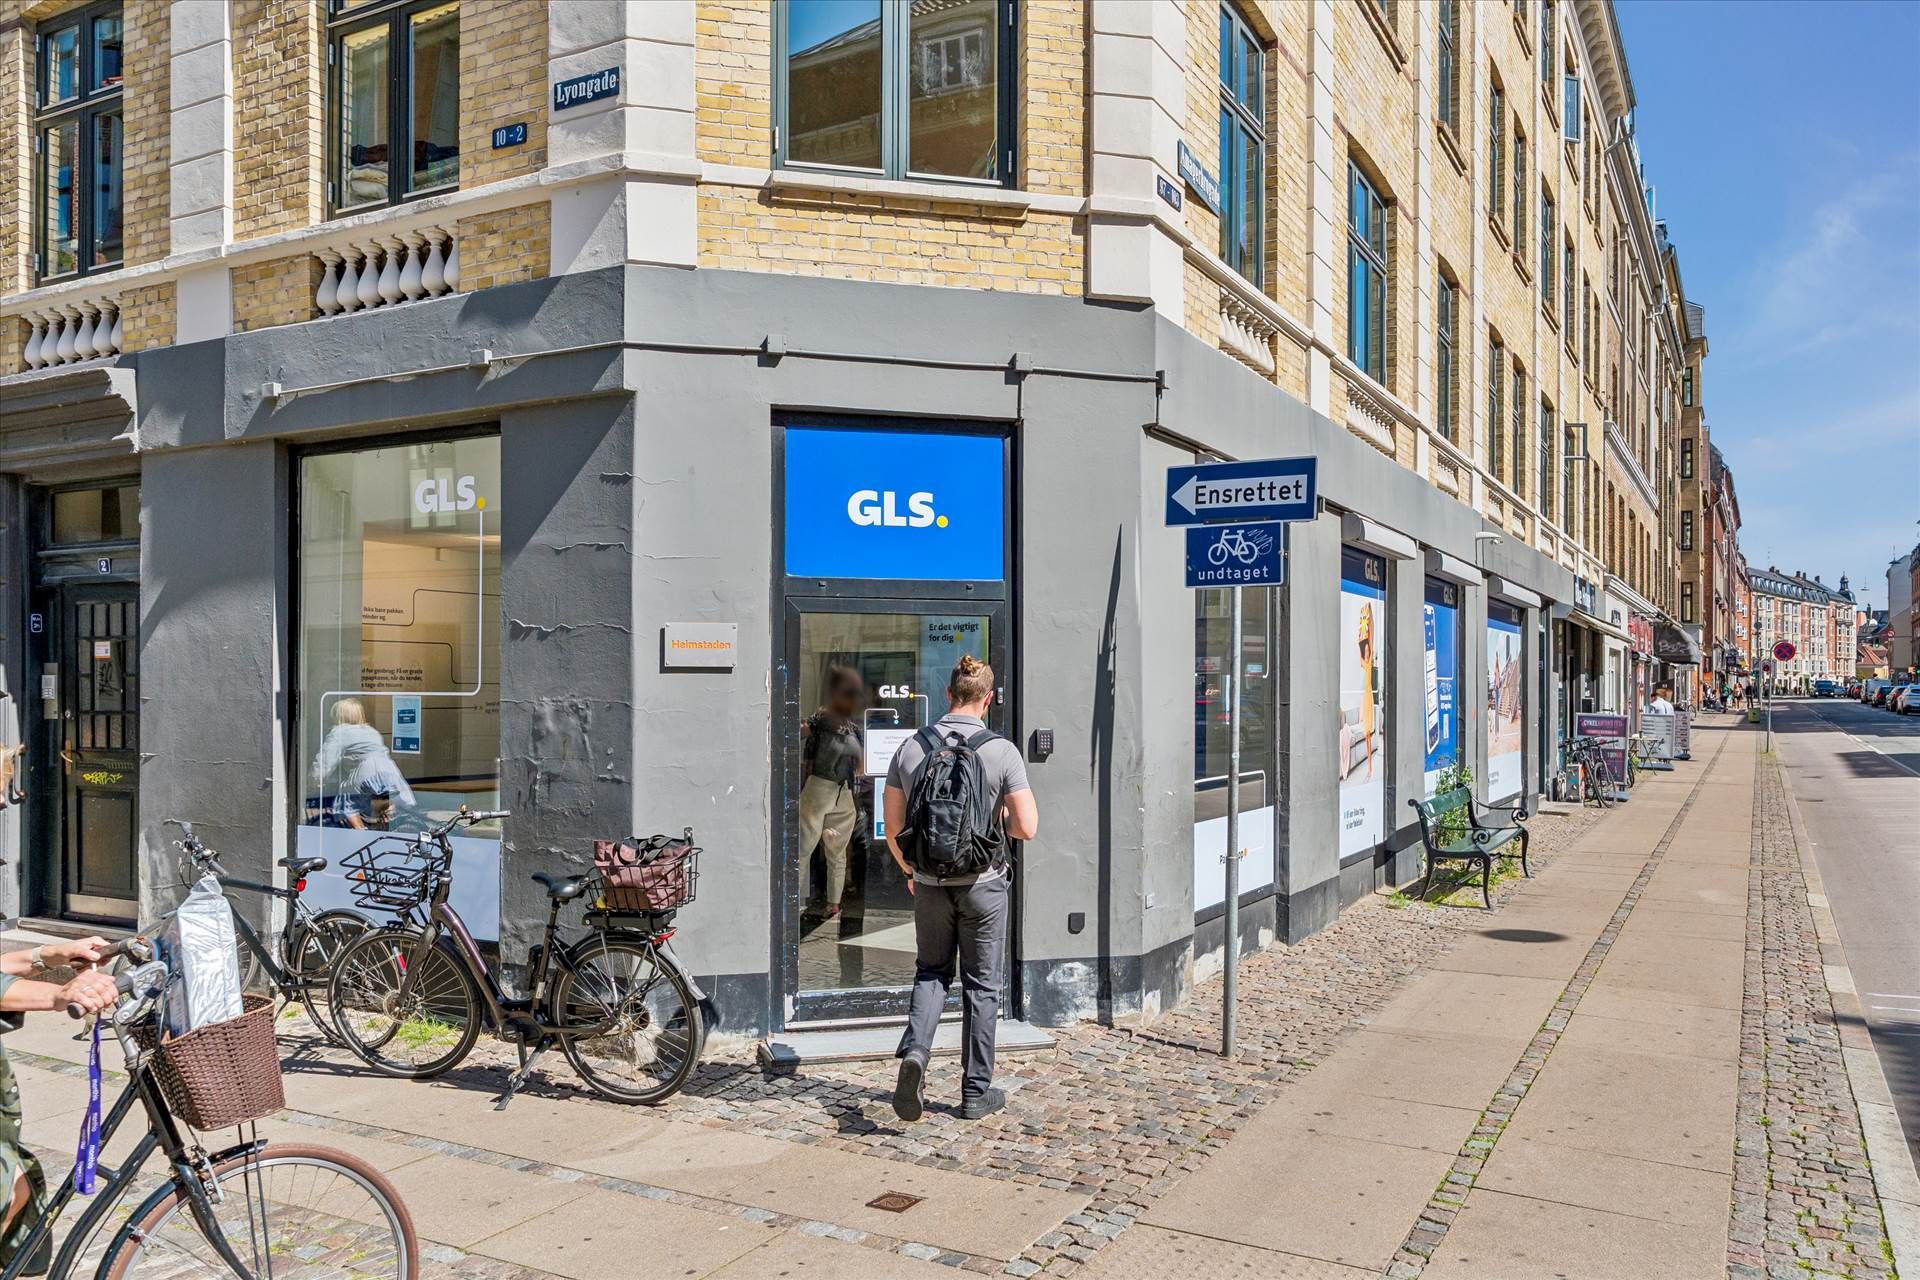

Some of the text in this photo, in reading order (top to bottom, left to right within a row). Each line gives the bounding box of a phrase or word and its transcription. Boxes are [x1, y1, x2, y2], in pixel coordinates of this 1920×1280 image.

[556, 71, 617, 105] Lyongade
[495, 129, 506, 147] 10
[516, 125, 523, 143] 2
[1194, 479, 1303, 505] Ensrettet
[100, 560, 107, 572] 2
[1198, 565, 1269, 581] undtaget
[928, 622, 979, 633] Er det vigtigt
[928, 634, 940, 642] for
